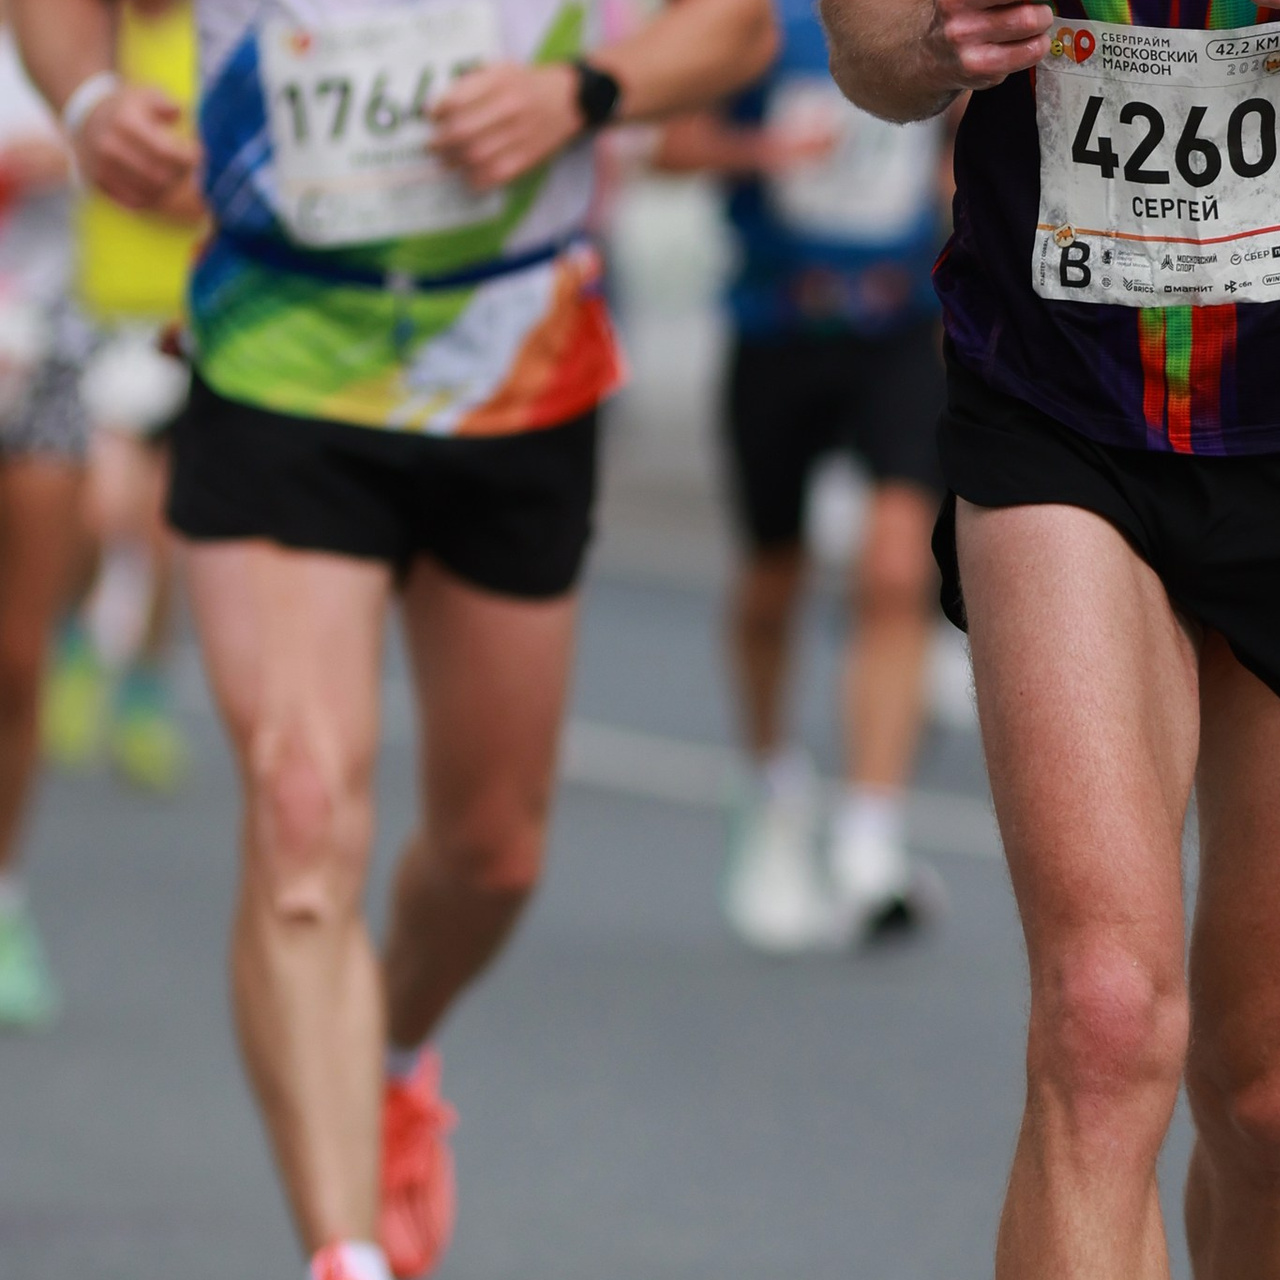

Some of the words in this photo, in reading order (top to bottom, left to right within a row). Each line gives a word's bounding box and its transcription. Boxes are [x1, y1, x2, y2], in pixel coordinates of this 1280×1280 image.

[1101, 31, 1171, 48] СБЕРПРАЙМ
[1214, 39, 1250, 57] 42,2
[1255, 36, 1279, 52] КМ
[1102, 44, 1198, 64] МОСКОВСКИЙ
[1102, 59, 1172, 76] МАРАФОН
[1226, 58, 1260, 76] 202
[279, 58, 484, 146] 1764
[1071, 95, 1277, 188] 4260
[1132, 195, 1219, 222] СЕРГЕЙ
[1177, 253, 1217, 265] МОСКОВСКИЙ
[1244, 250, 1270, 261] СБЕР
[1176, 264, 1195, 272] СПОРТ
[1173, 285, 1213, 293] магнит
